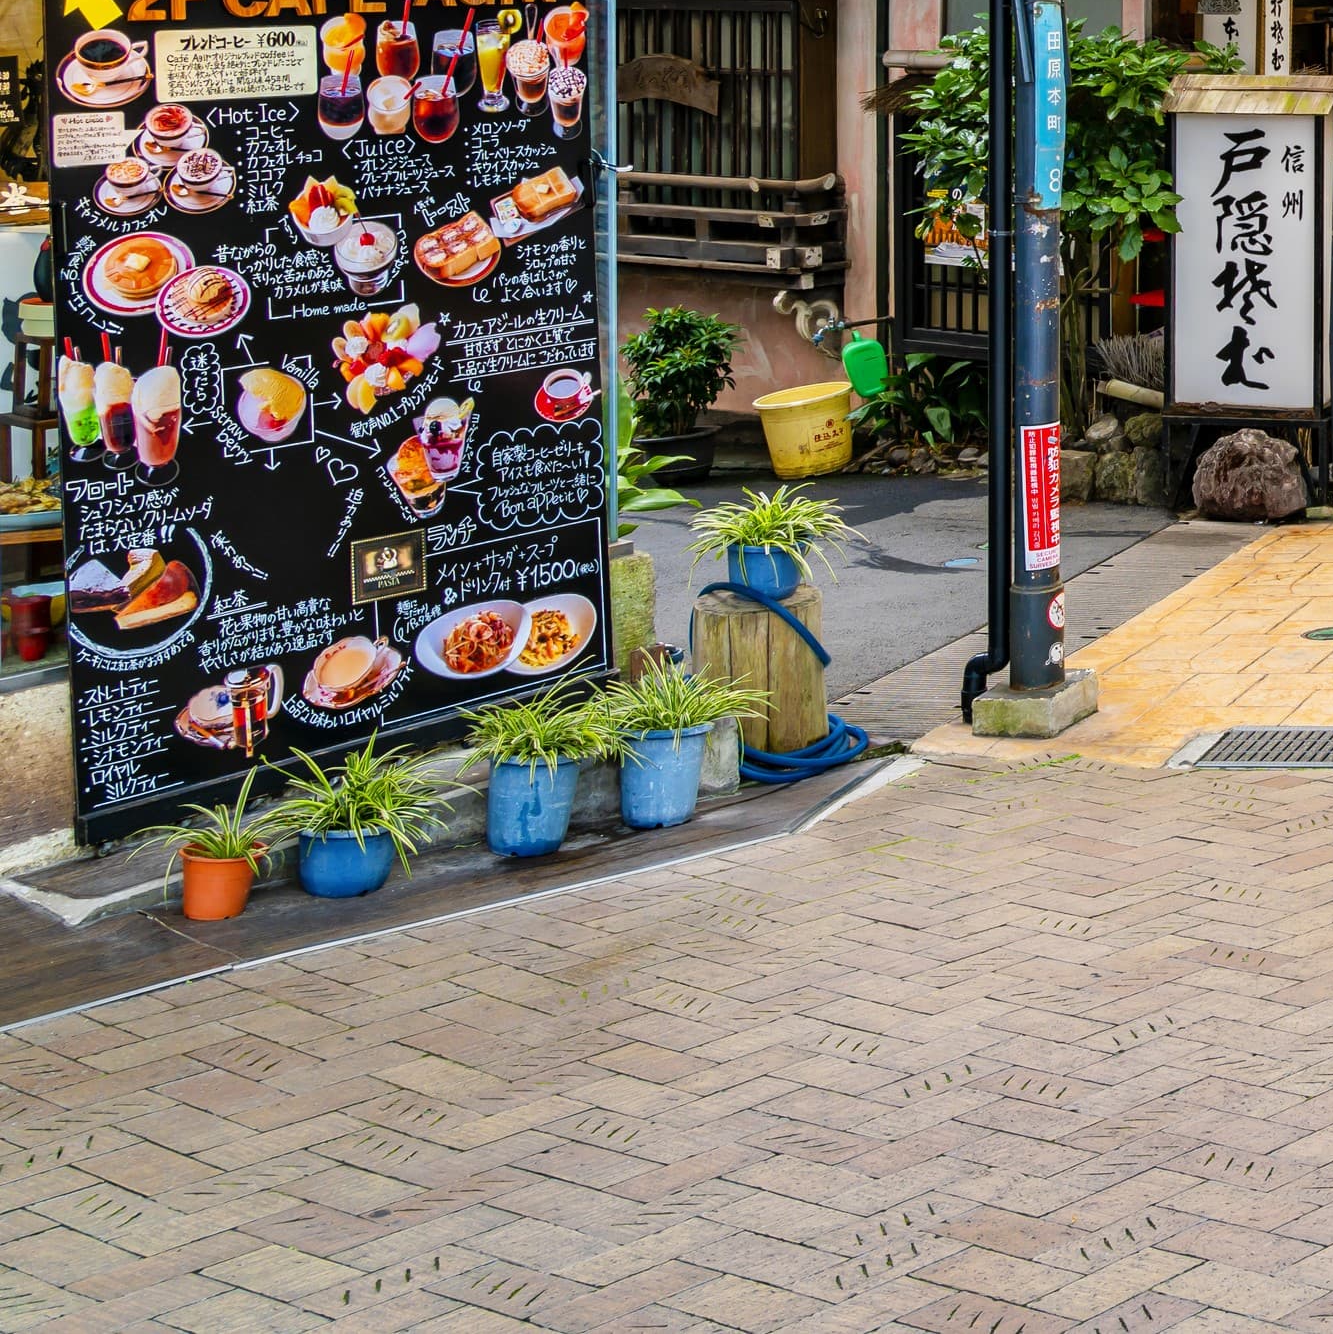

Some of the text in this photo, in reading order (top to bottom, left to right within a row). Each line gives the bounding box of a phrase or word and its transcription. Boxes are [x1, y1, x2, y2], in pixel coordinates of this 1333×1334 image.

[180, 33, 252, 51] ブレンドコーヒー
[1047, 31, 1062, 193] 田原本町 8
[246, 127, 295, 140] コーヒー
[472, 119, 532, 136] メロンソーダ
[246, 139, 297, 155] カフェオレ
[471, 135, 500, 149] コーラ
[472, 144, 557, 161] ブルーベリースカッシュ
[360, 154, 432, 172] オレンジジュース
[472, 159, 540, 174] キウイスカッシュ
[247, 168, 286, 183] ココア
[360, 165, 456, 186] グレープフルーツジュース
[473, 172, 518, 188] レモネード
[1282, 144, 1305, 221] 信州
[248, 181, 284, 199] ミルク
[362, 180, 431, 200] バナナジュース
[247, 197, 280, 215] 紅茶
[423, 193, 471, 227] トースト
[213, 243, 277, 264] 昔ながらの
[517, 235, 587, 259] シナモンの香りと
[237, 250, 330, 275] しっかりした食感と
[524, 254, 578, 270] シロップの甘さ
[493, 269, 569, 289] パンの香ばしさが
[292, 299, 368, 319] Home made
[452, 305, 585, 340] カフェアジールの生クリーム
[66, 473, 134, 503] フロート
[494, 500, 525, 518] Bon
[427, 516, 478, 552] ランチ
[213, 590, 250, 615] 紅茶
[84, 676, 159, 707] ストレートティー
[89, 700, 154, 724] レモンティー
[90, 718, 160, 745] ミルクティー
[91, 733, 174, 765] シナモンティー
[91, 760, 141, 786] ロイヤル
[106, 772, 170, 801] ミルクティー
